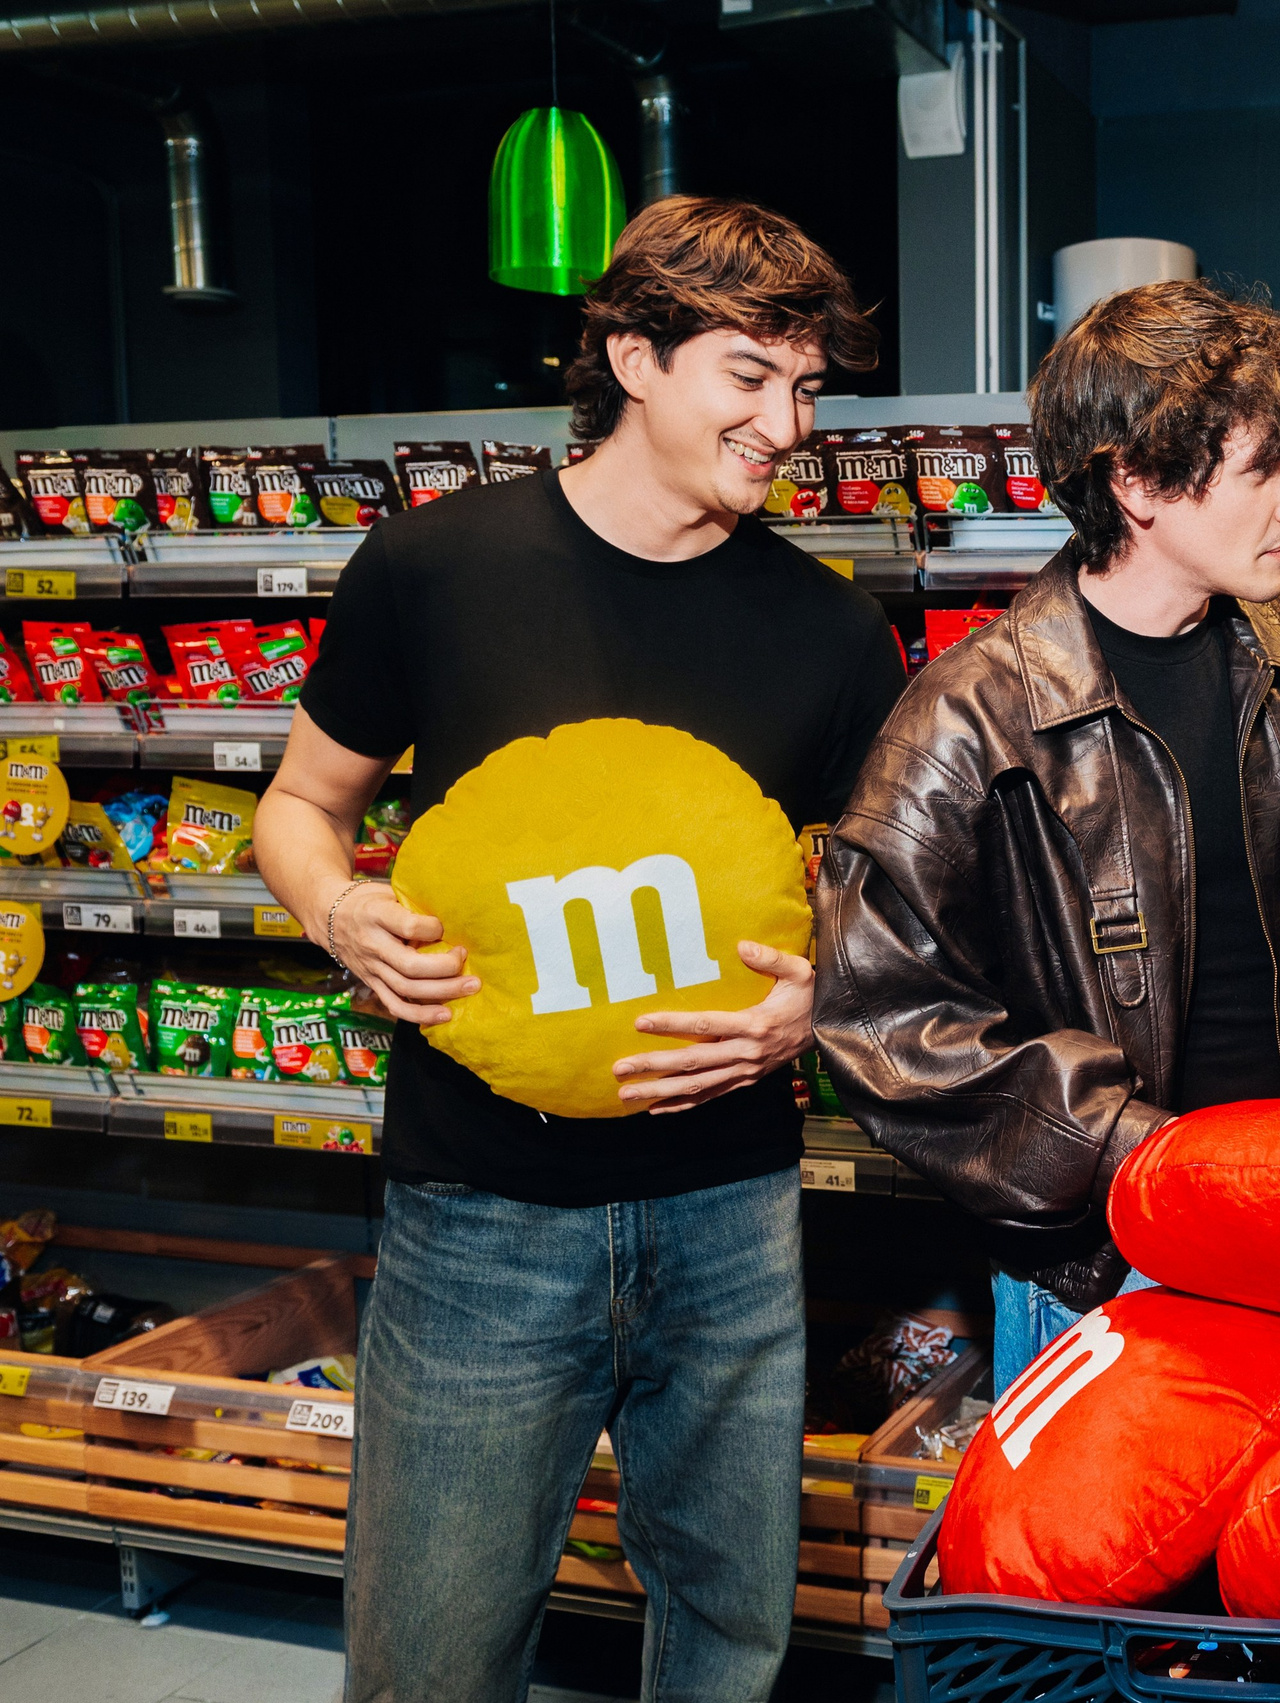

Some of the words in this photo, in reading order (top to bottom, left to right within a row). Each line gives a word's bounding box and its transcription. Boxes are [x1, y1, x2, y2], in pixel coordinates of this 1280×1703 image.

[93, 913, 111, 928] 79
[506, 854, 720, 1014] m
[16, 1106, 33, 1121] 72
[826, 1175, 840, 1187] 41
[991, 1306, 1125, 1470] m
[121, 1390, 148, 1407] 139
[311, 1412, 344, 1431] 209
